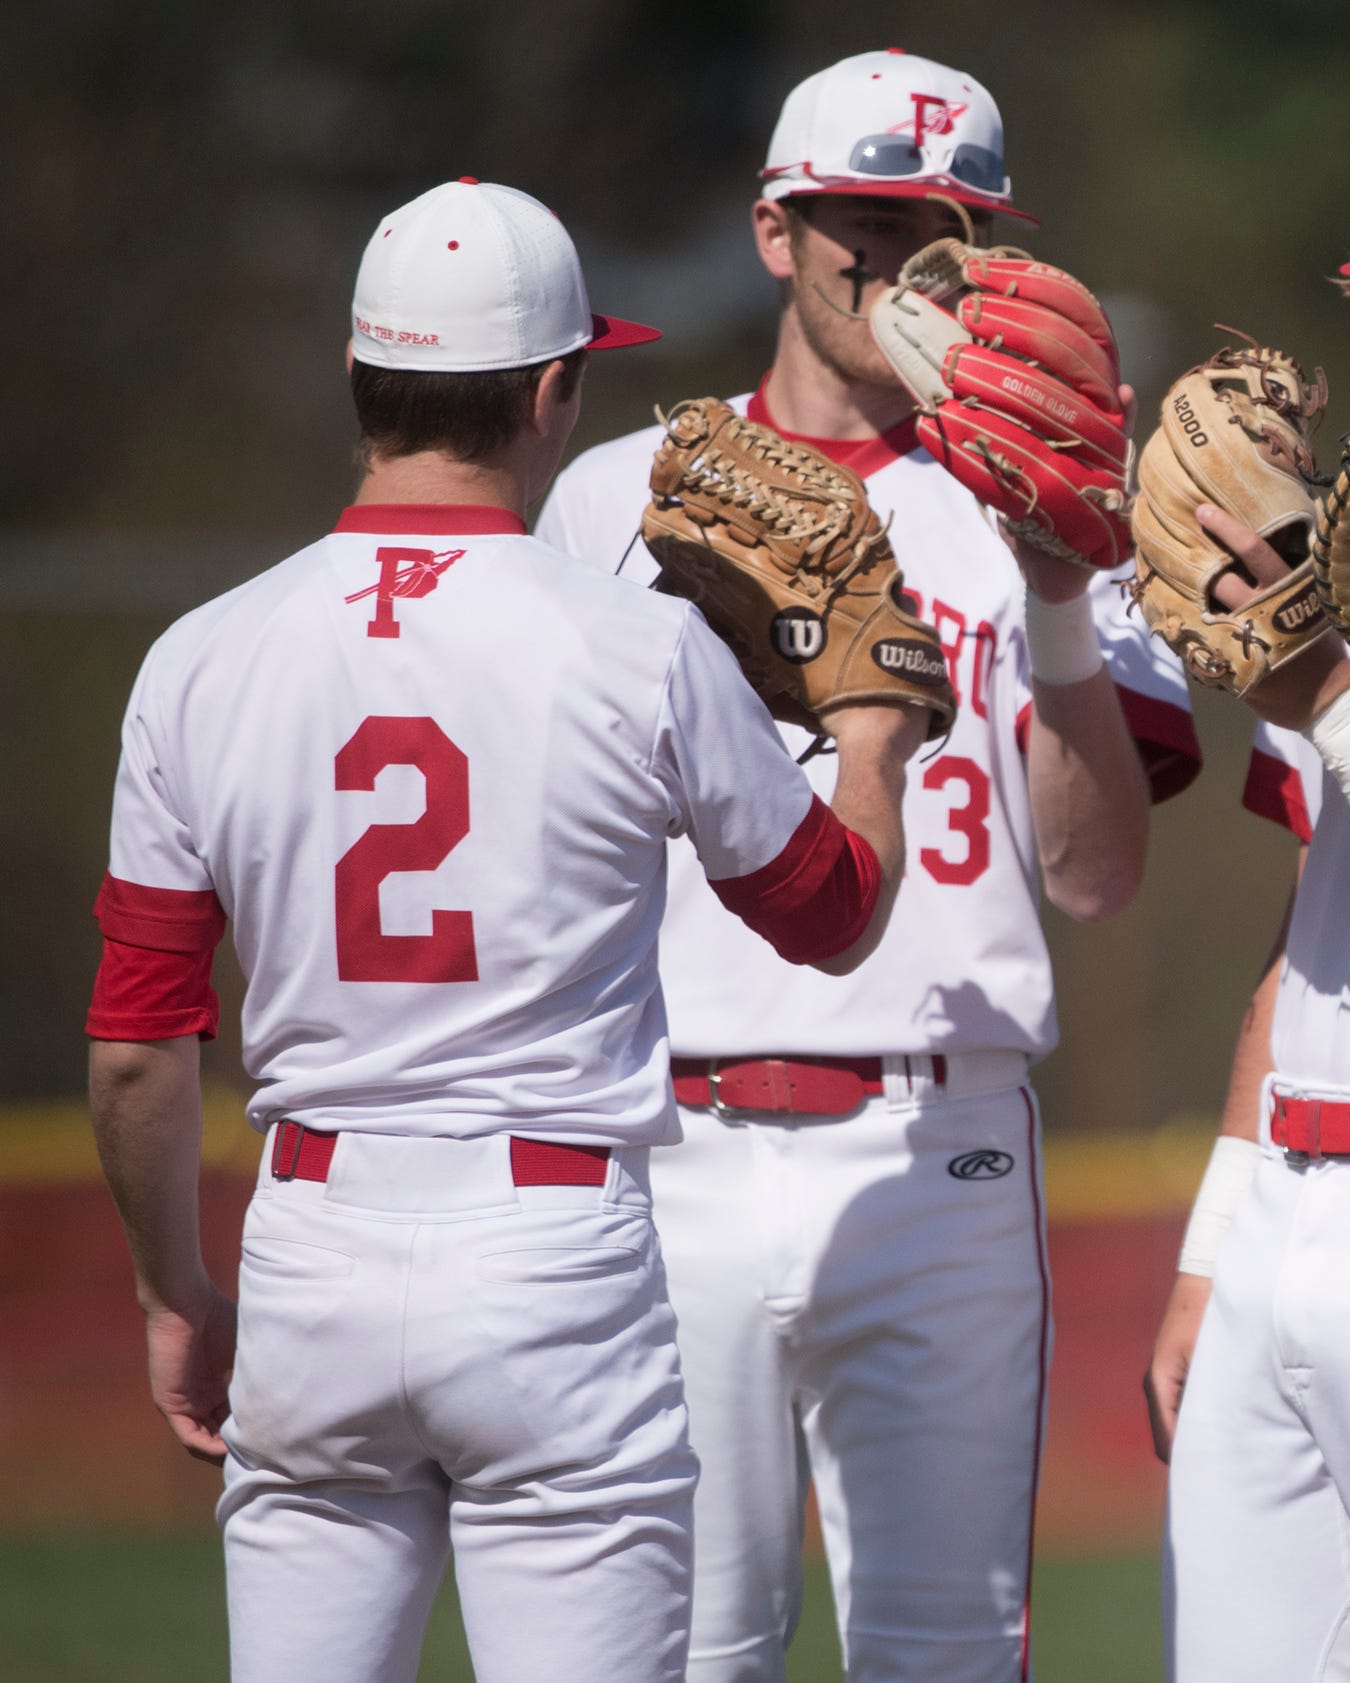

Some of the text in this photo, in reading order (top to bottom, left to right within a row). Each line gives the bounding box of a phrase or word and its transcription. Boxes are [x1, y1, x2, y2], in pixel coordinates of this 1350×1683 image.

[374, 325, 394, 341] THE
[398, 331, 439, 346] SPEAR
[1002, 376, 1046, 406] GOLDEN
[1173, 392, 1209, 448] A2000
[367, 547, 438, 638] P
[1278, 591, 1320, 630] Wil
[880, 643, 946, 678] Wilson
[903, 755, 991, 887] 3
[334, 715, 479, 984] 2
